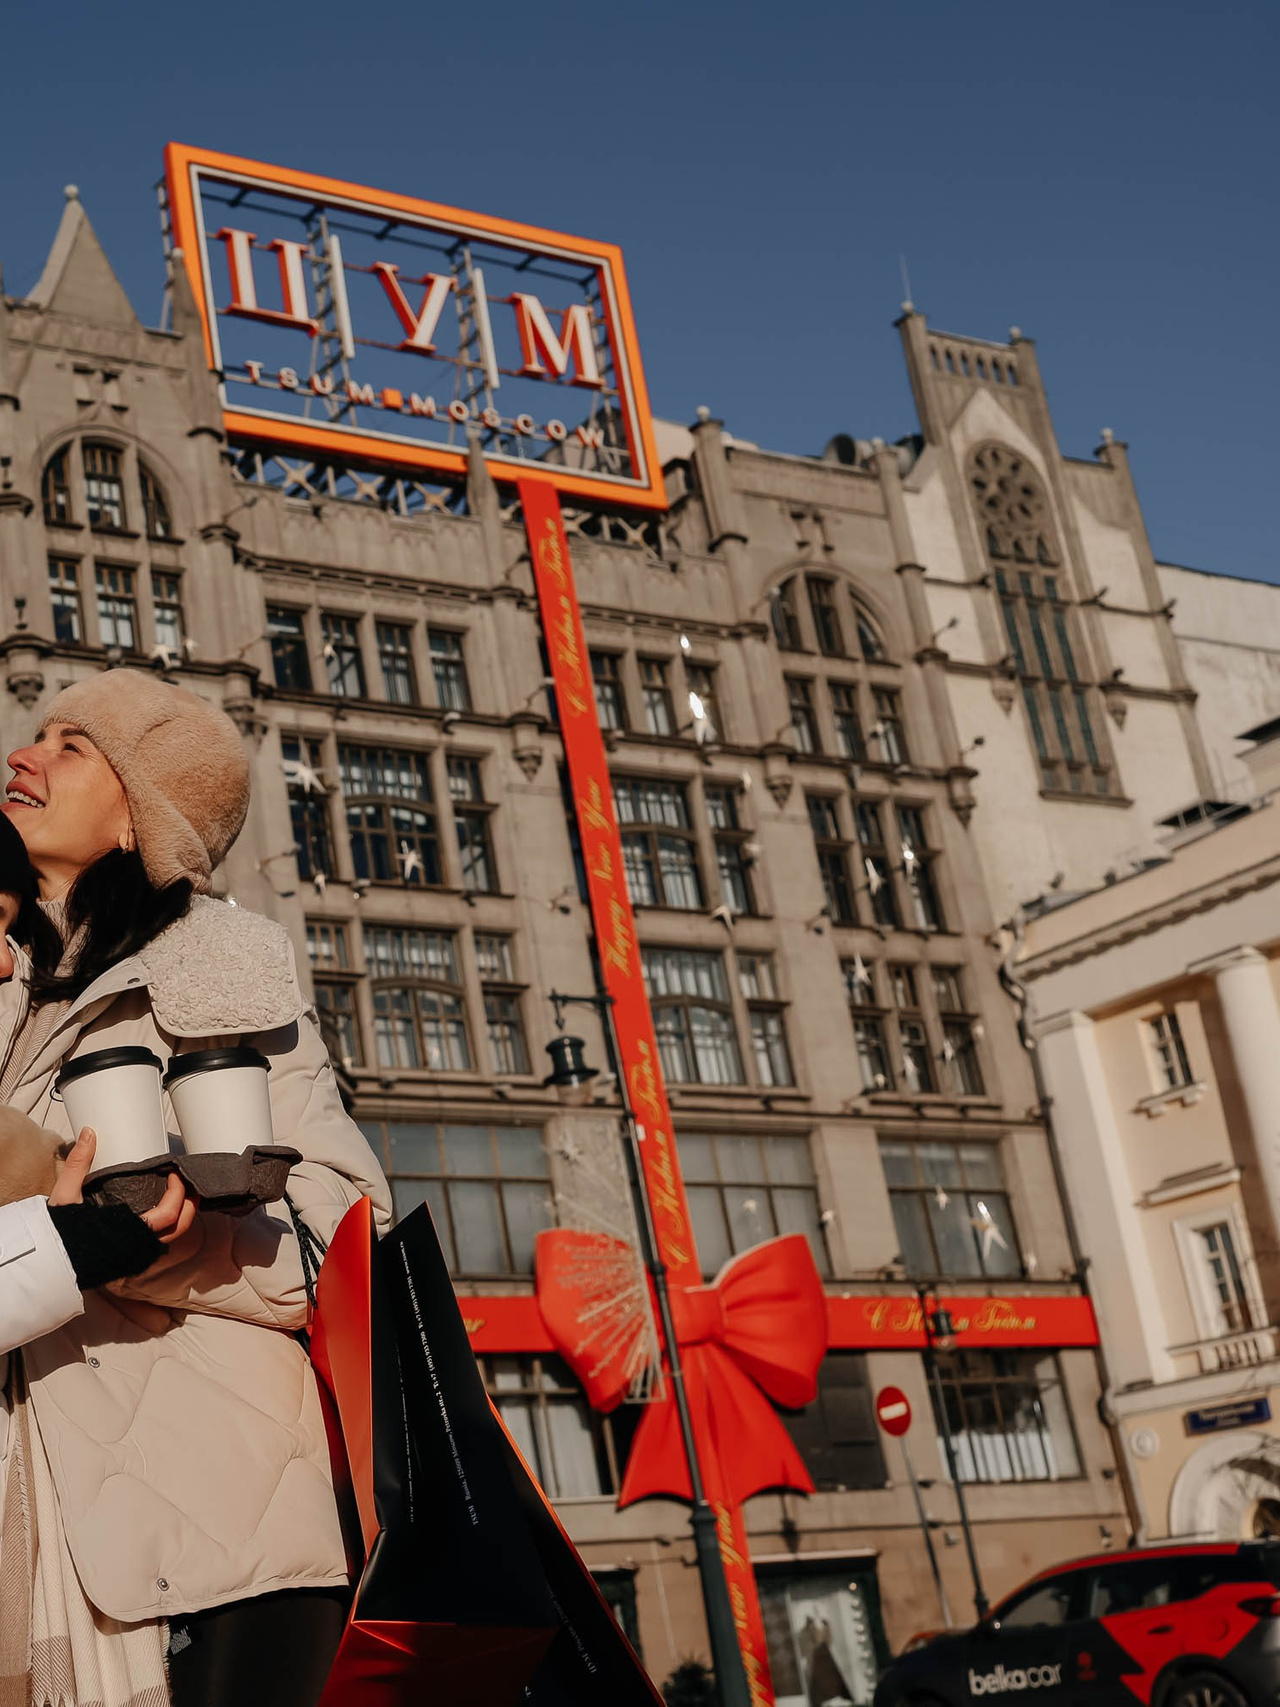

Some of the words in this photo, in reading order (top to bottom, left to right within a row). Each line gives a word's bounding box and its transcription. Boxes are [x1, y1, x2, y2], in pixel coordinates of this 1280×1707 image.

[244, 359, 375, 404] TSUM
[410, 392, 604, 448] MOSCOW
[967, 1663, 1062, 1696] belkacar
